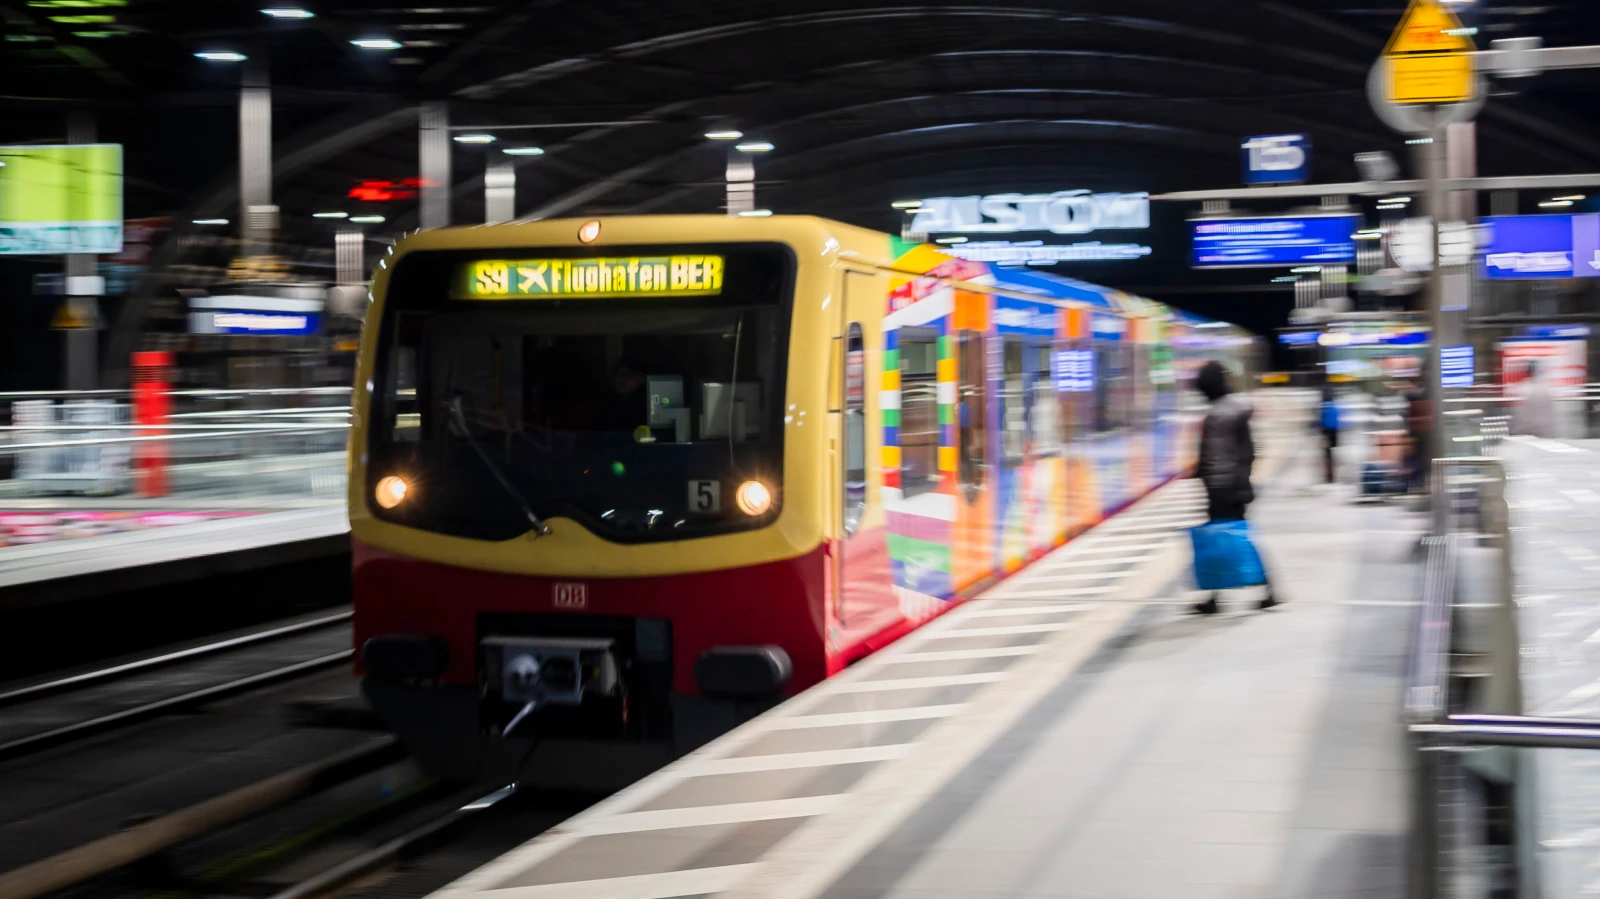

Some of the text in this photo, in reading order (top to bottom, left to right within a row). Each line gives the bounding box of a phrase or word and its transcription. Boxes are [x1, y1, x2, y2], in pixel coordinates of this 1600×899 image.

[1242, 134, 1306, 172] 15
[476, 255, 723, 294] S9 Flughafen BER
[697, 482, 713, 510] 5
[556, 584, 585, 606] DB
